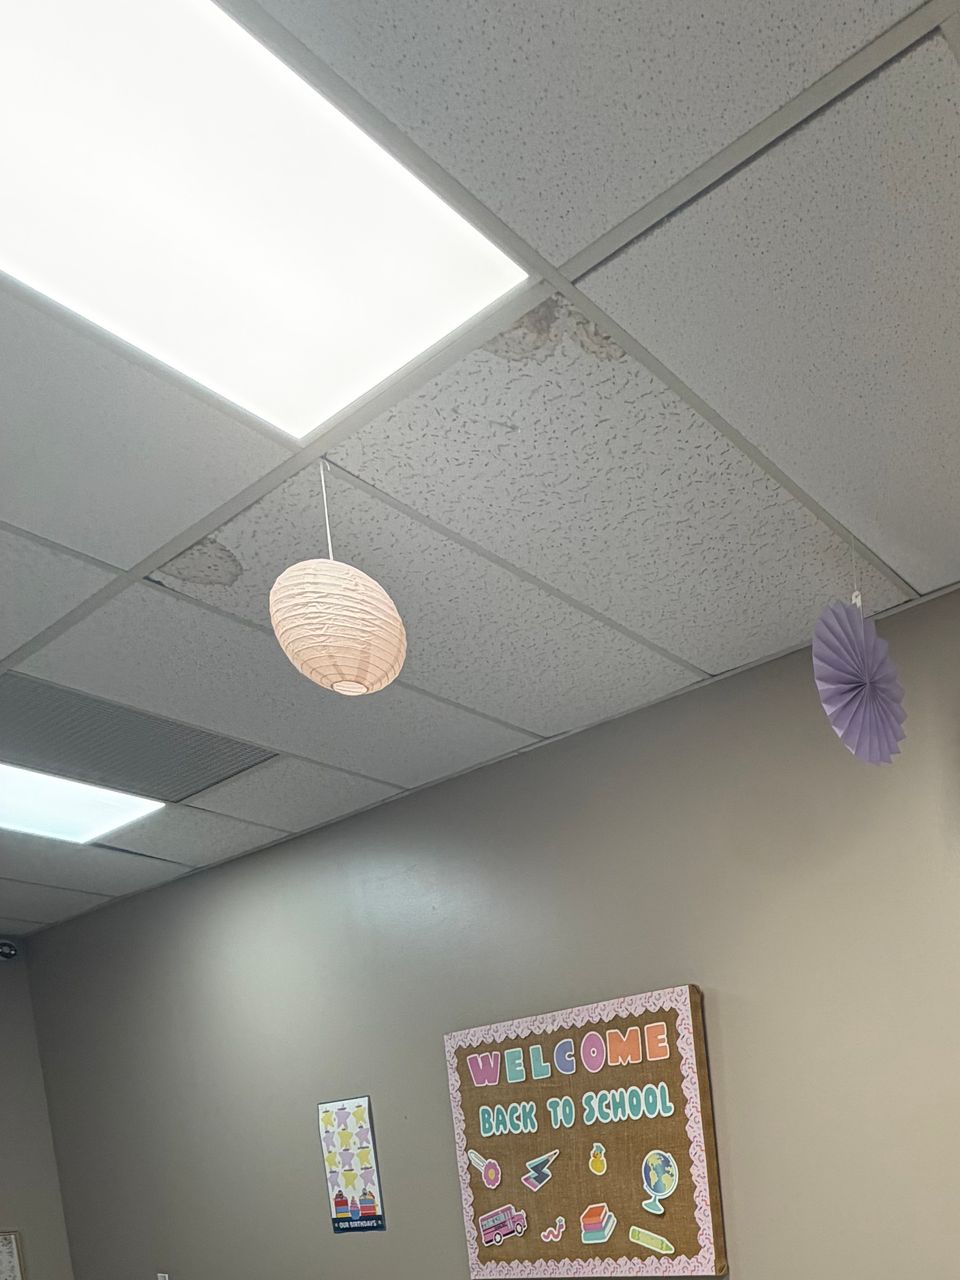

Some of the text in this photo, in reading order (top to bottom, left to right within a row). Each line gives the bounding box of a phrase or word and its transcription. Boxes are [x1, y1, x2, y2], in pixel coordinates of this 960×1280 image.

[466, 1021, 670, 1087] WELCOME
[479, 1081, 675, 1137] BACK TO SCHOOL
